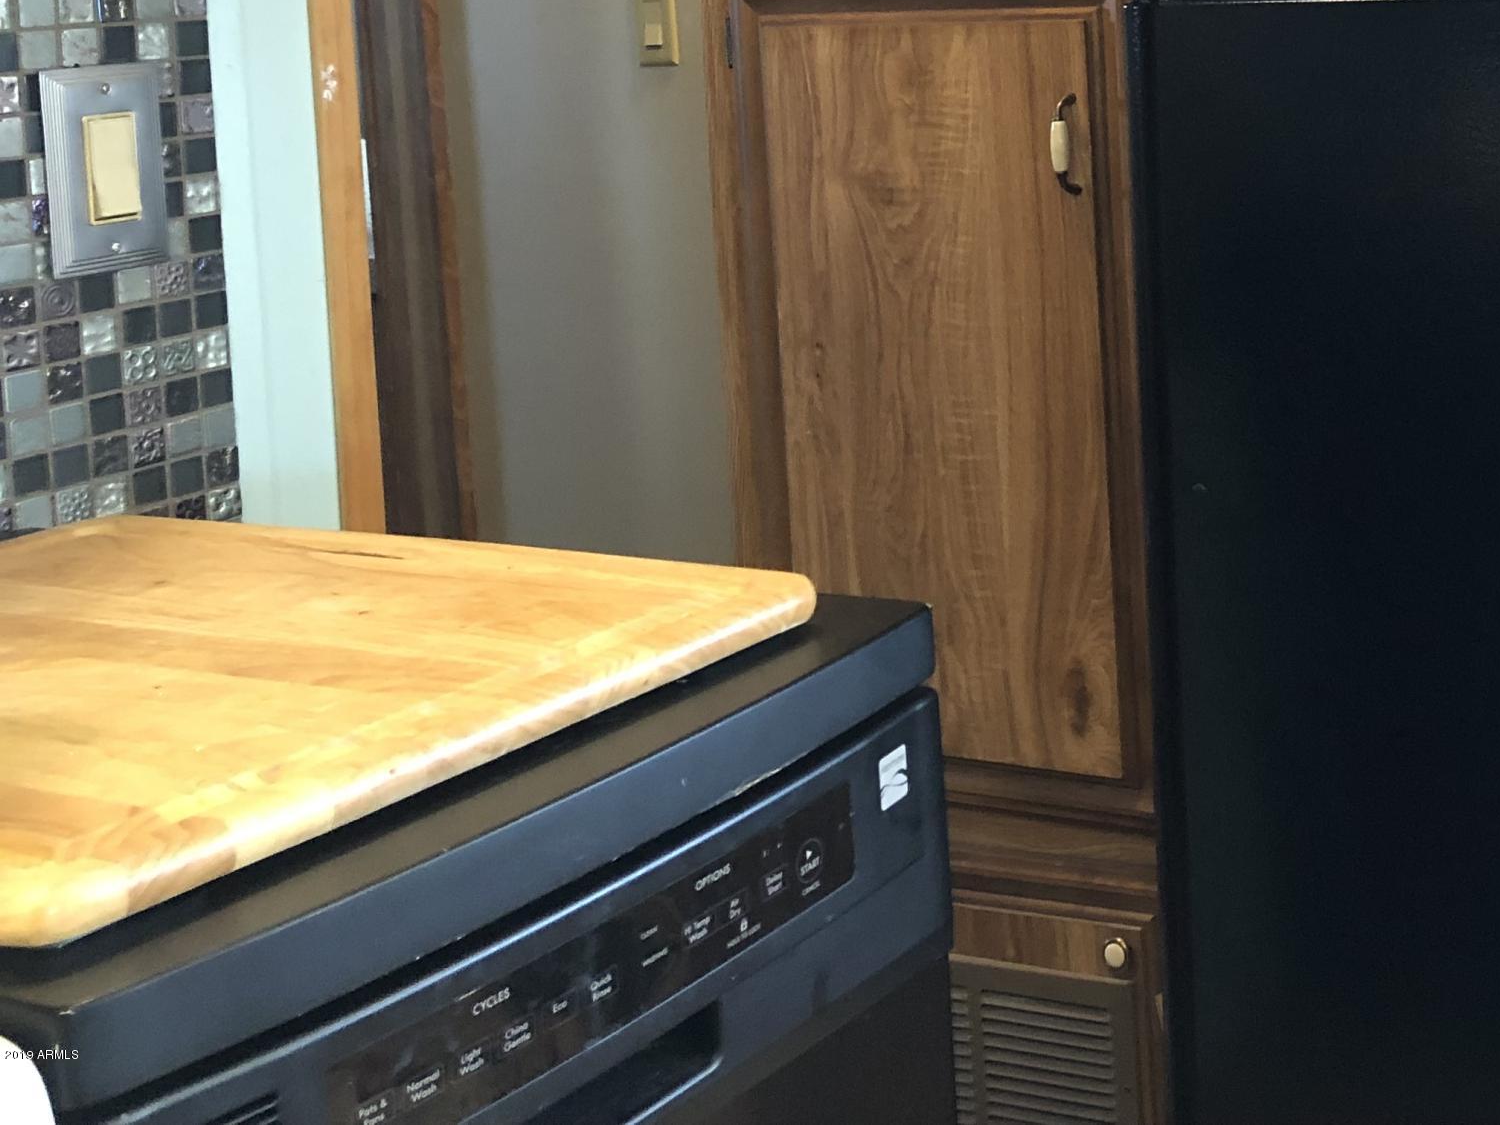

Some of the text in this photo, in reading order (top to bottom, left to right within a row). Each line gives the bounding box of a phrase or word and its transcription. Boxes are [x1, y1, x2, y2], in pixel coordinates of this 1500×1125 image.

[801, 856, 820, 876] START
[694, 863, 731, 891] OPTIONS
[472, 987, 511, 1016] CYCLES
[552, 1000, 568, 1013] Eco
[505, 1022, 529, 1040] China
[503, 1032, 531, 1052] Gentle
[461, 1047, 482, 1065] Light
[459, 1057, 484, 1075] Wash
[406, 1069, 440, 1093] Normal
[411, 1084, 437, 1102] Wash
[380, 1099, 388, 1109] &
